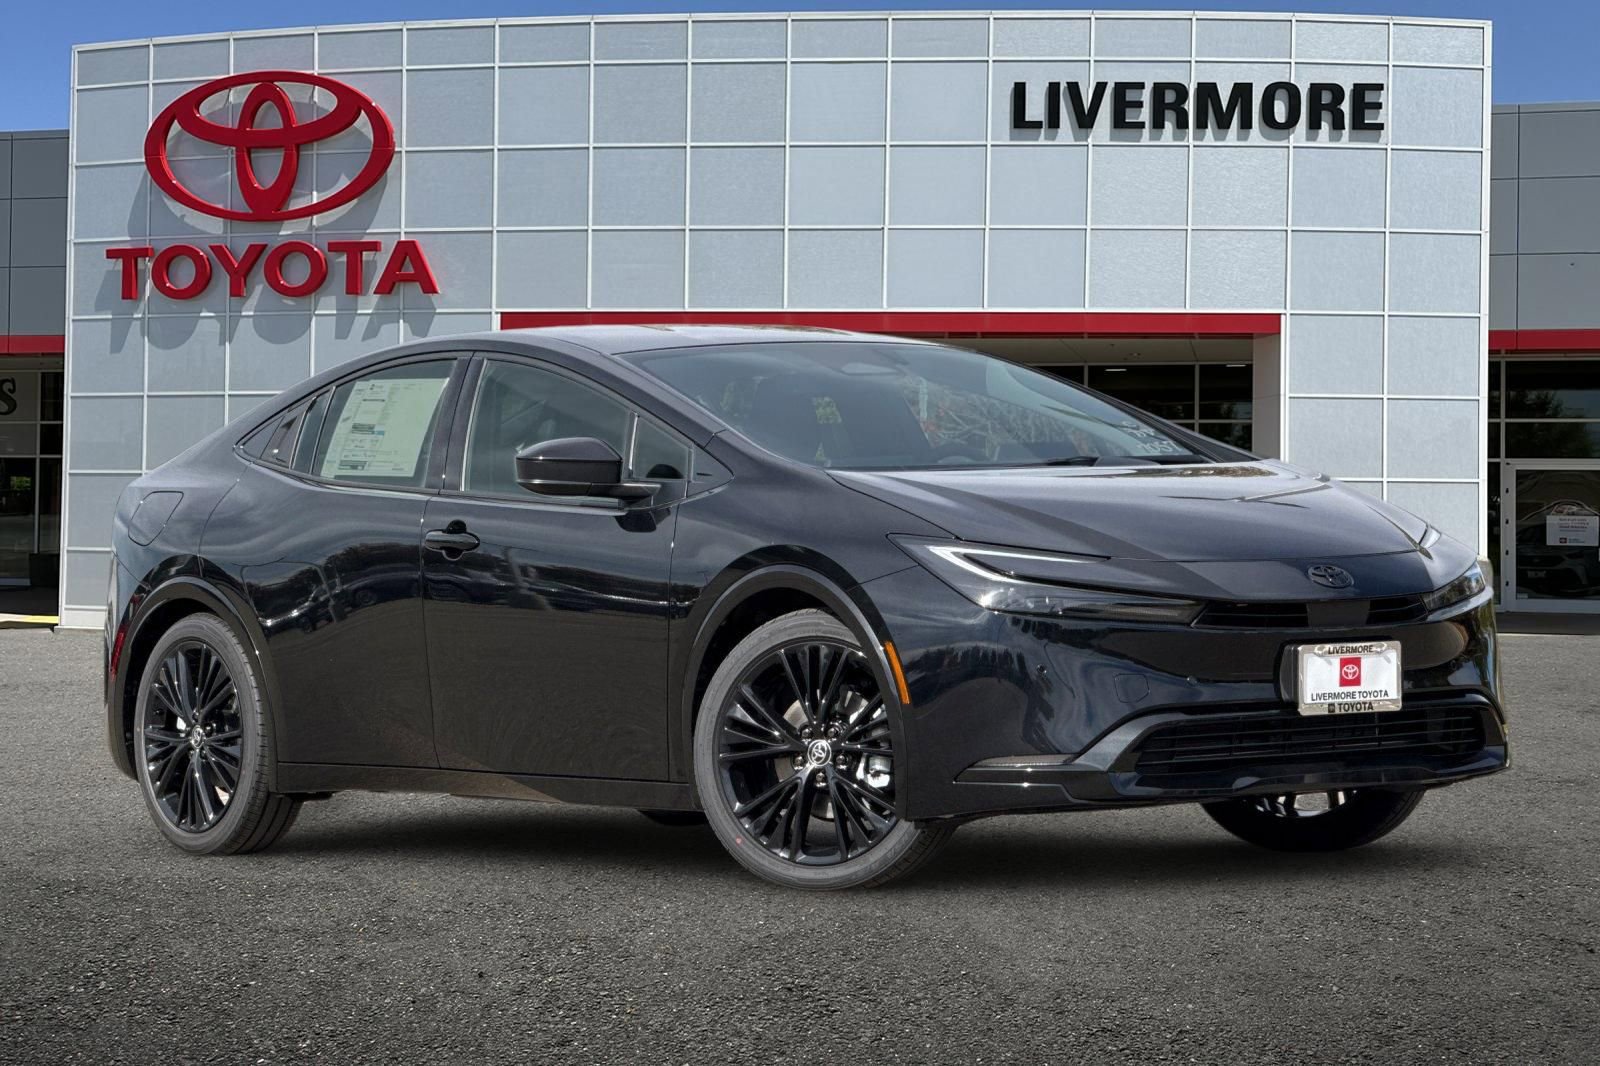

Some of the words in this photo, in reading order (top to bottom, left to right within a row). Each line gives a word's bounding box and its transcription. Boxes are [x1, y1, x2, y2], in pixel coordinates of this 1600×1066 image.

[1012, 81, 1385, 131] LIVERMORE
[106, 239, 440, 300] TOYOTA
[1328, 645, 1374, 655] LIVERMORE
[1311, 691, 1356, 701] LIVERMORE
[1358, 689, 1389, 699] TOYOTA
[1338, 702, 1374, 713] TOYOTA
